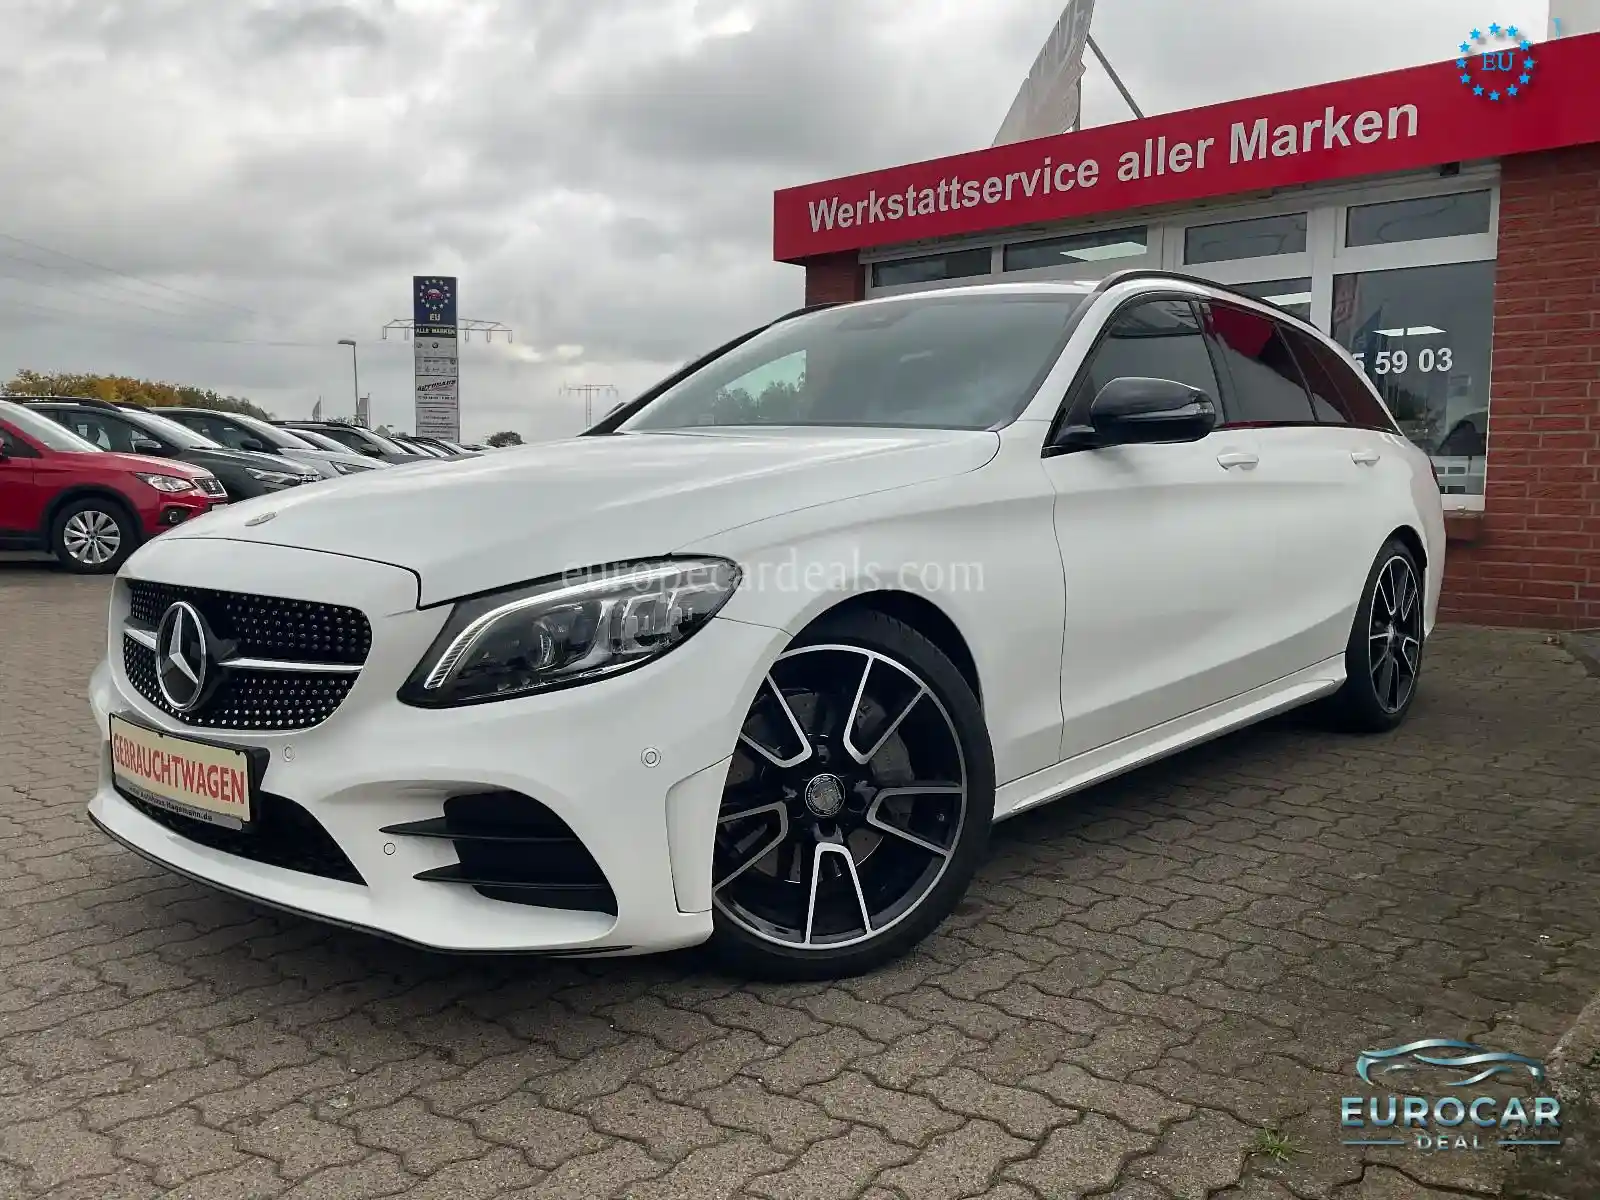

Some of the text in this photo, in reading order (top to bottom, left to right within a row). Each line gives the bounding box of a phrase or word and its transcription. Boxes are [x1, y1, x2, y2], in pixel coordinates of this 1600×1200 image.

[808, 103, 1420, 233] Werkstattservice aller Marken
[429, 313, 441, 321] EU
[1375, 350, 1408, 375] 59
[1418, 347, 1453, 373] 03
[113, 733, 245, 805] GEBRAUCHTWAGEN
